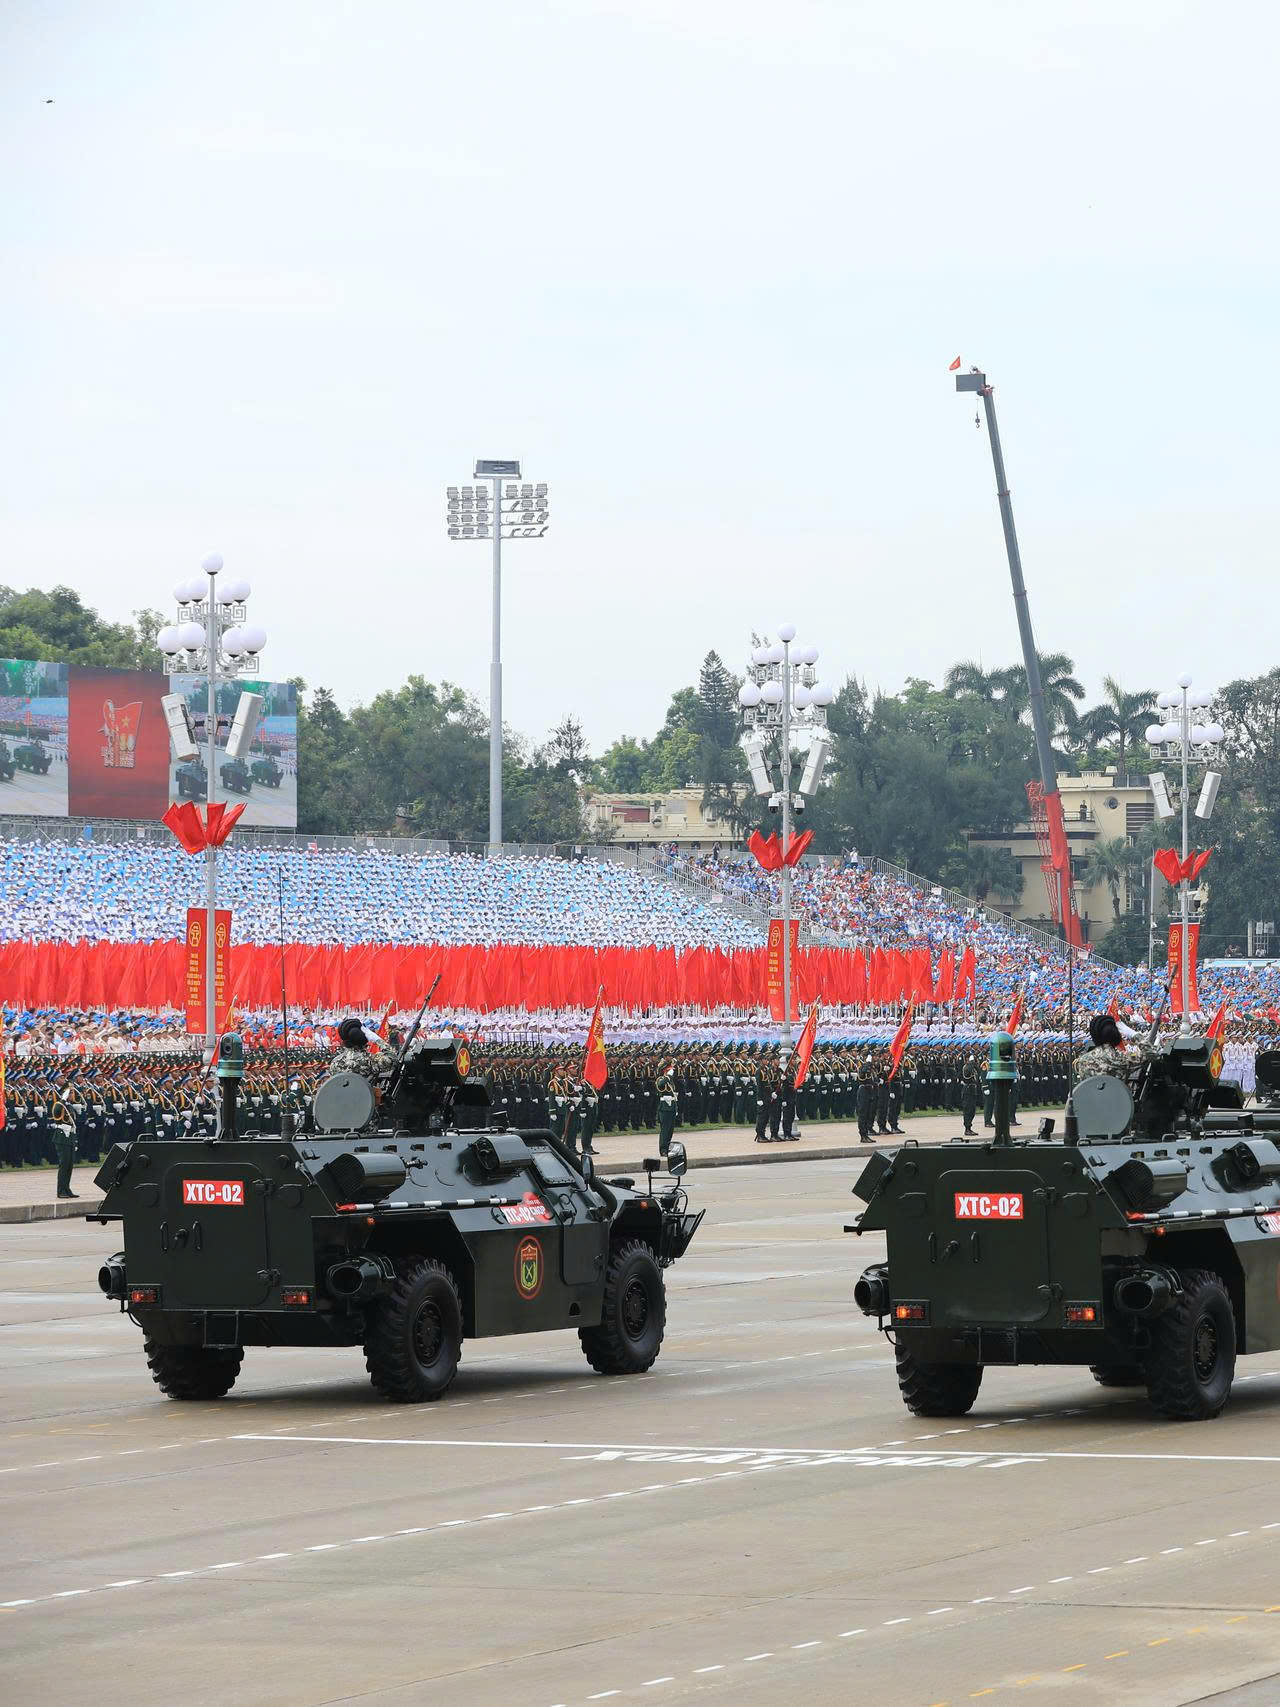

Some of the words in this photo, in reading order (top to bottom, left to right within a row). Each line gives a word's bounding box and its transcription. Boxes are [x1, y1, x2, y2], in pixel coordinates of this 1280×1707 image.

[185, 1183, 242, 1202] XTC-02
[501, 1206, 536, 1223] XTC-02
[958, 1196, 1021, 1216] XTC-02
